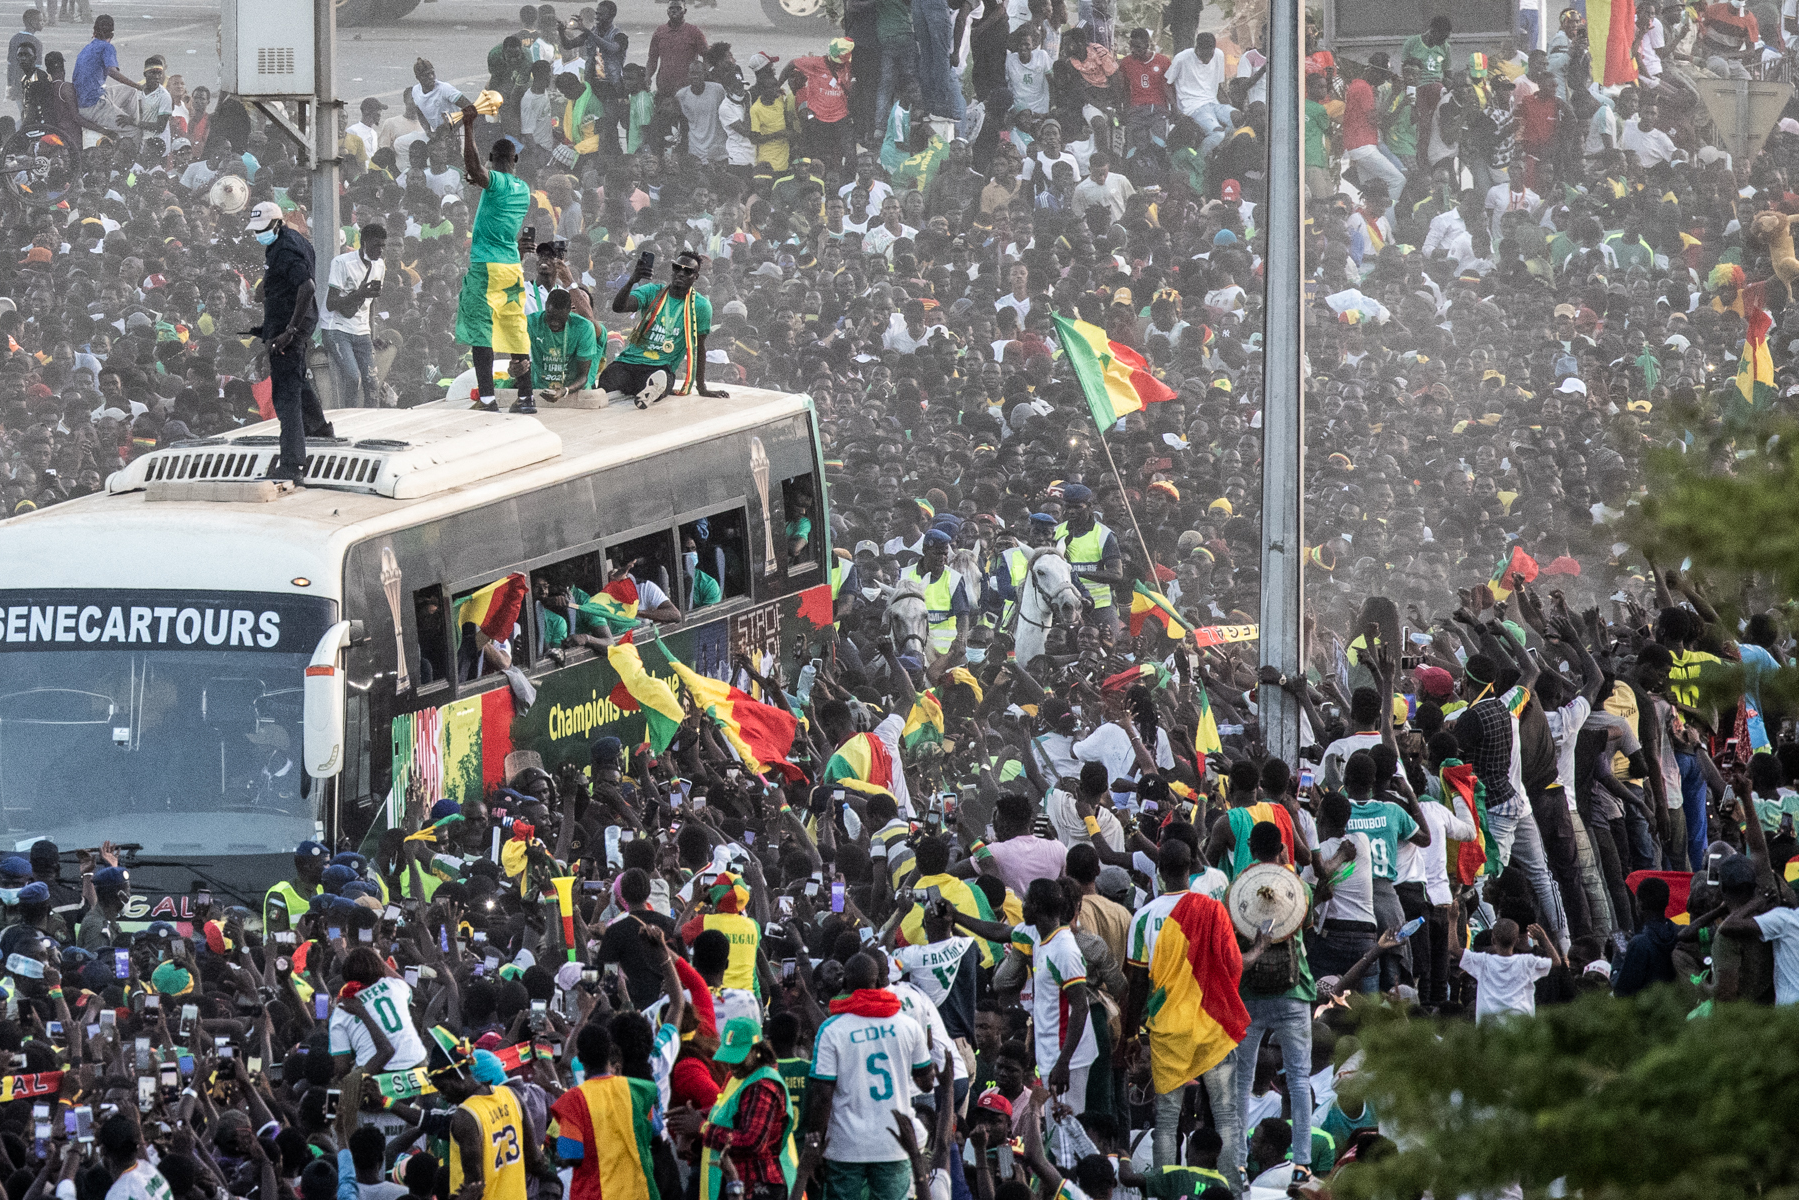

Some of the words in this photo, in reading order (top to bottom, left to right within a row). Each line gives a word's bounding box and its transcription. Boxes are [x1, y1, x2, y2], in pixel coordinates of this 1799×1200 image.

[1023, 73, 1033, 85] 45
[1140, 73, 1150, 88] 6
[549, 689, 620, 741] Champions
[1347, 815, 1387, 831] HIOUBOU
[724, 932, 756, 945] NEGAL
[849, 1023, 896, 1044] CDK
